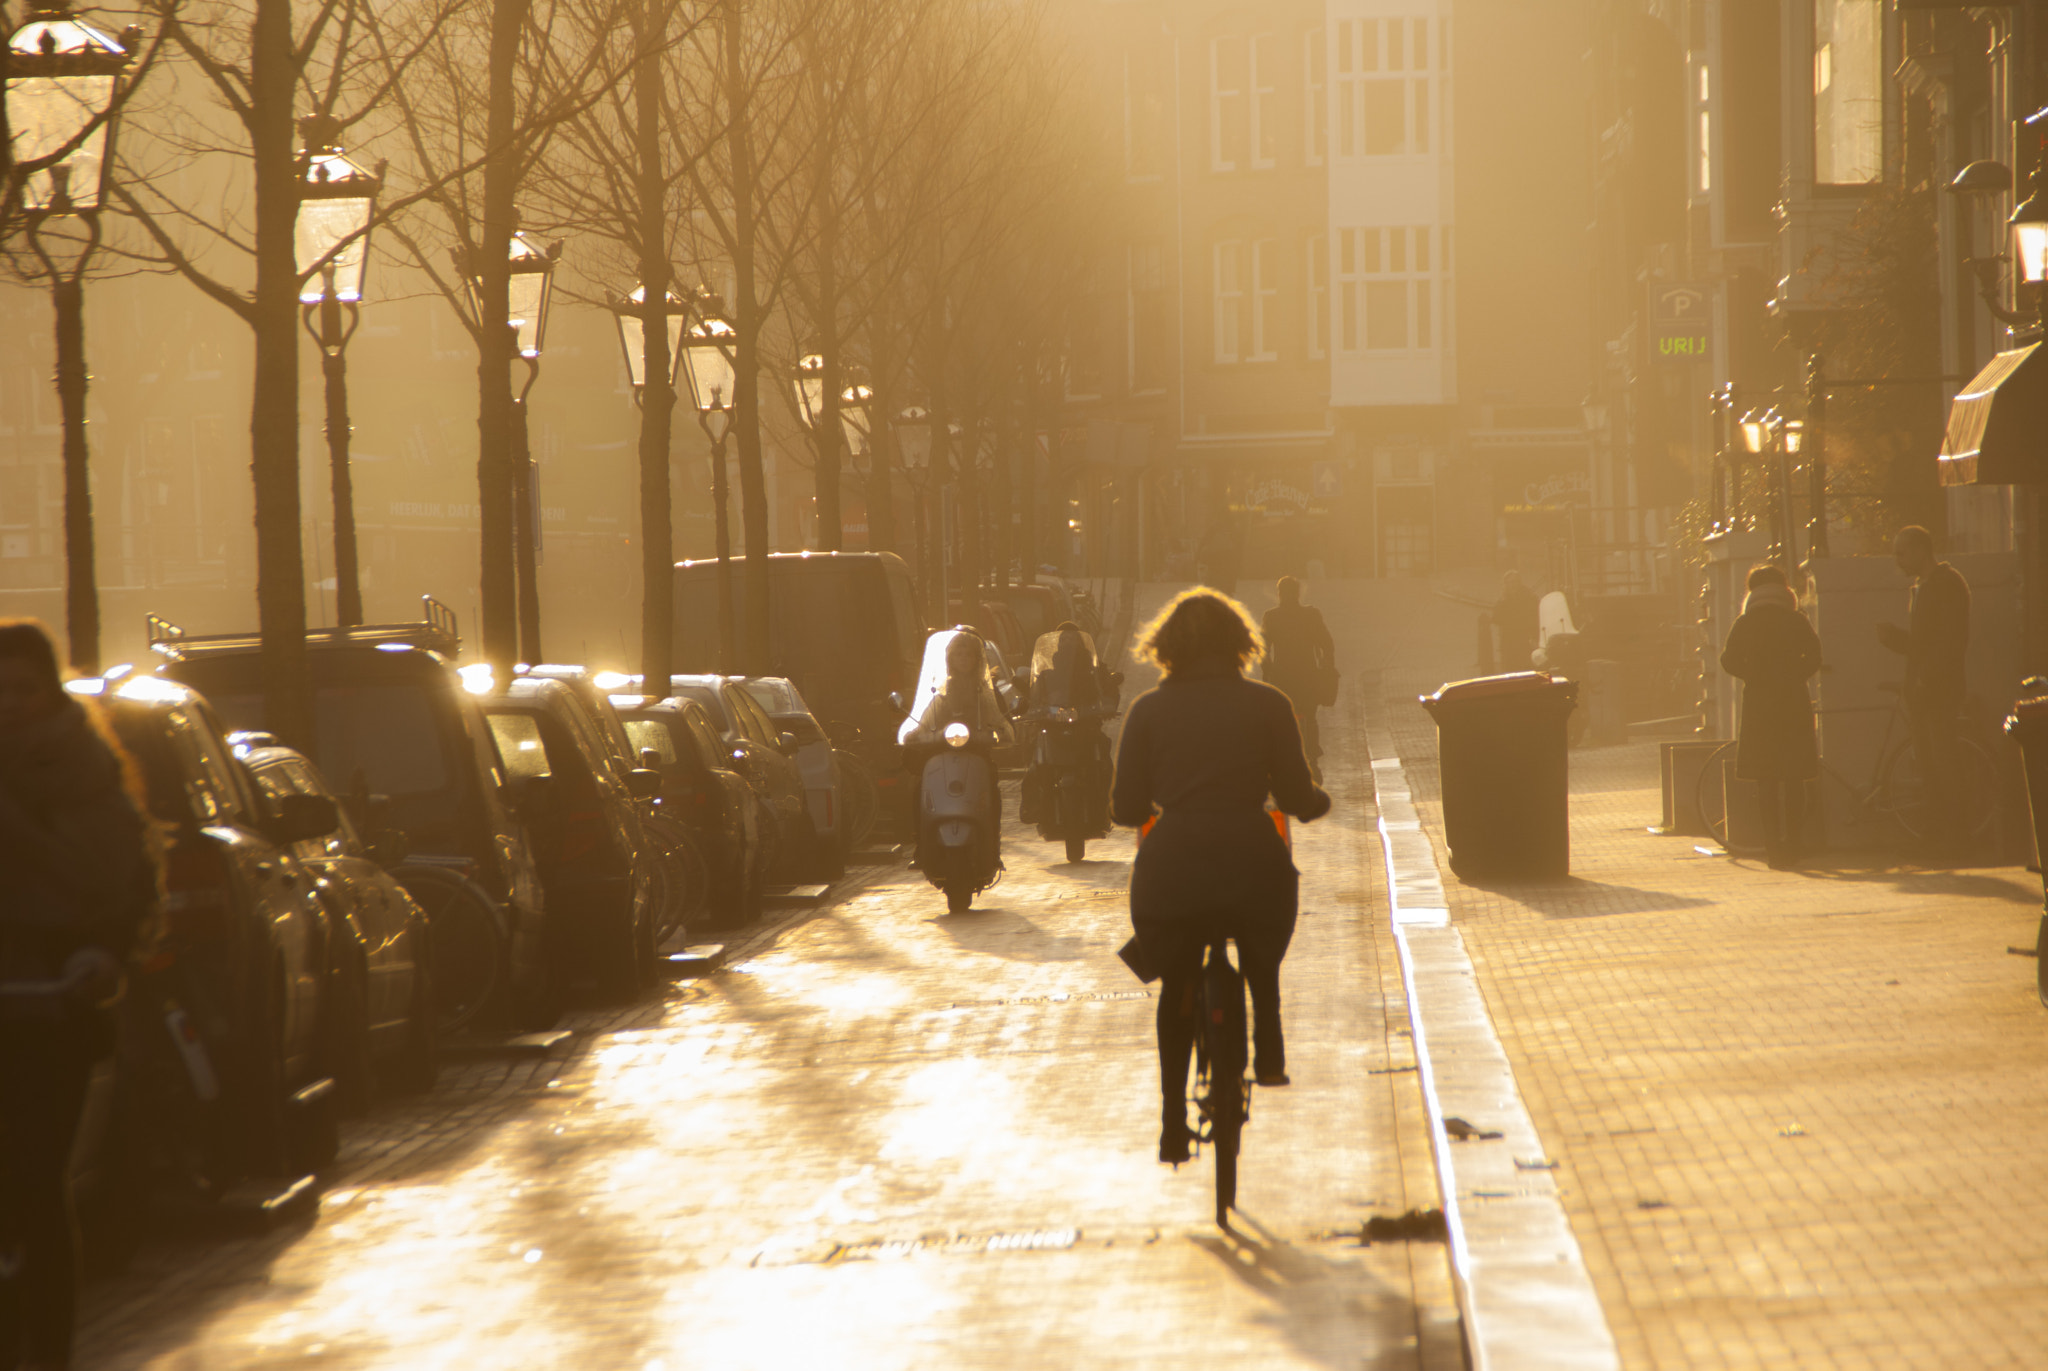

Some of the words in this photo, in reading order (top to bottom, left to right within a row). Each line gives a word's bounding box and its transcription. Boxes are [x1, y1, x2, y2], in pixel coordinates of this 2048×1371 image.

[1675, 296, 1690, 316] P
[1660, 336, 1706, 355] VRIJ
[448, 504, 472, 518] DAT
